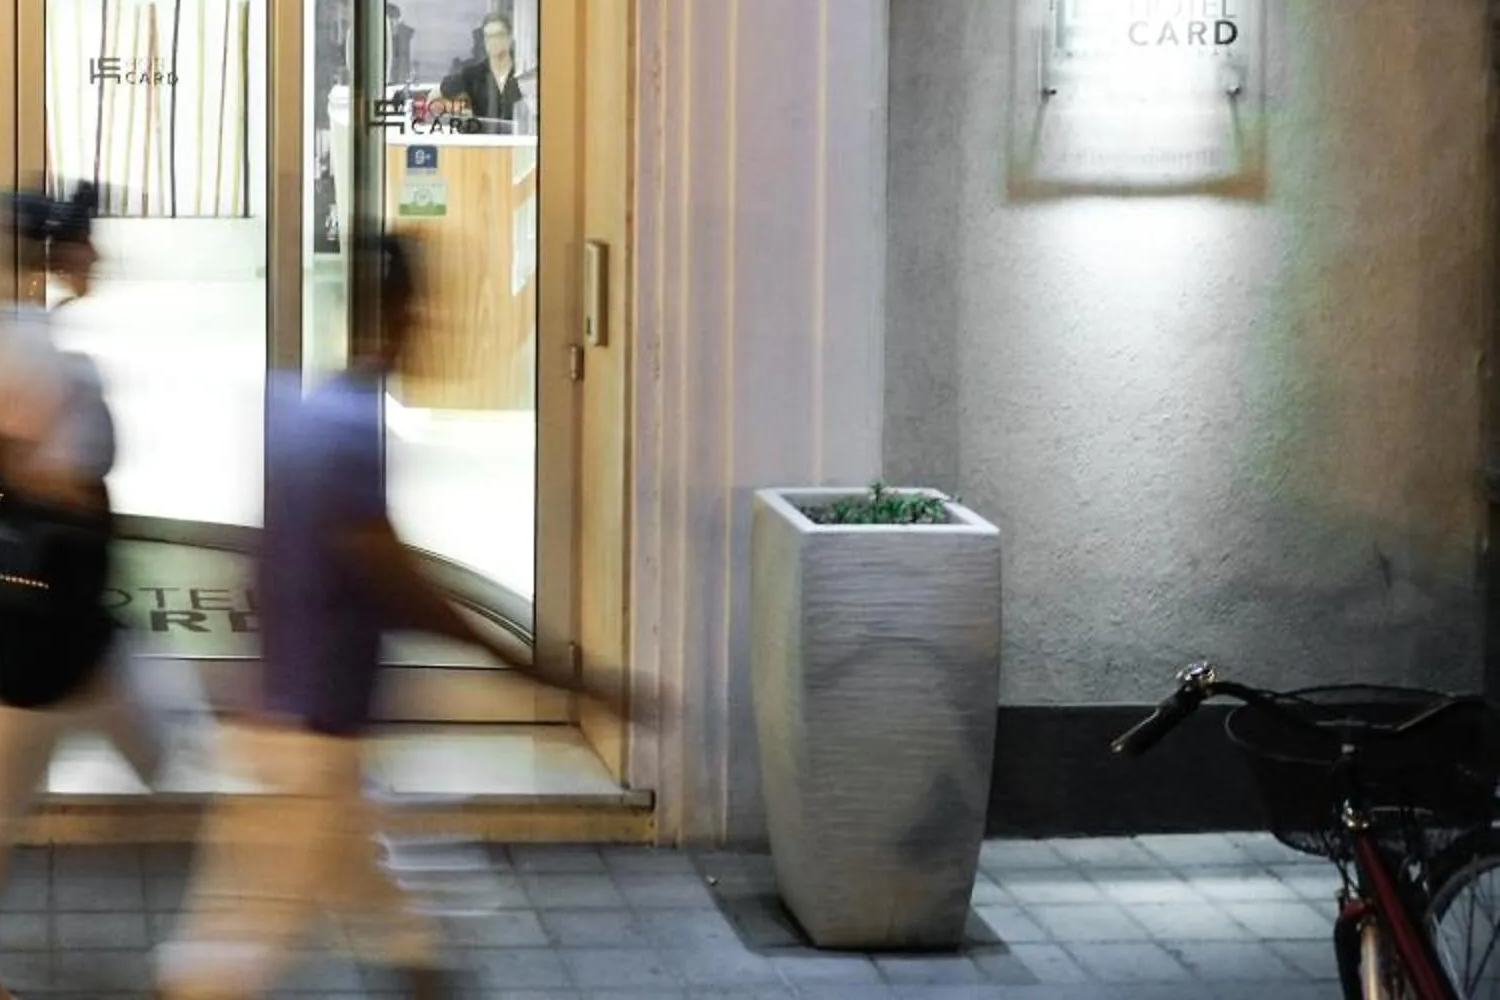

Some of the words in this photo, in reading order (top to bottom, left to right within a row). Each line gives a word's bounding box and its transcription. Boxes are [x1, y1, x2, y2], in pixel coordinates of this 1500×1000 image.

[1128, 19, 1239, 46] CARD
[125, 71, 179, 86] CARD
[411, 117, 482, 135] CARD
[97, 586, 263, 611] OTEL
